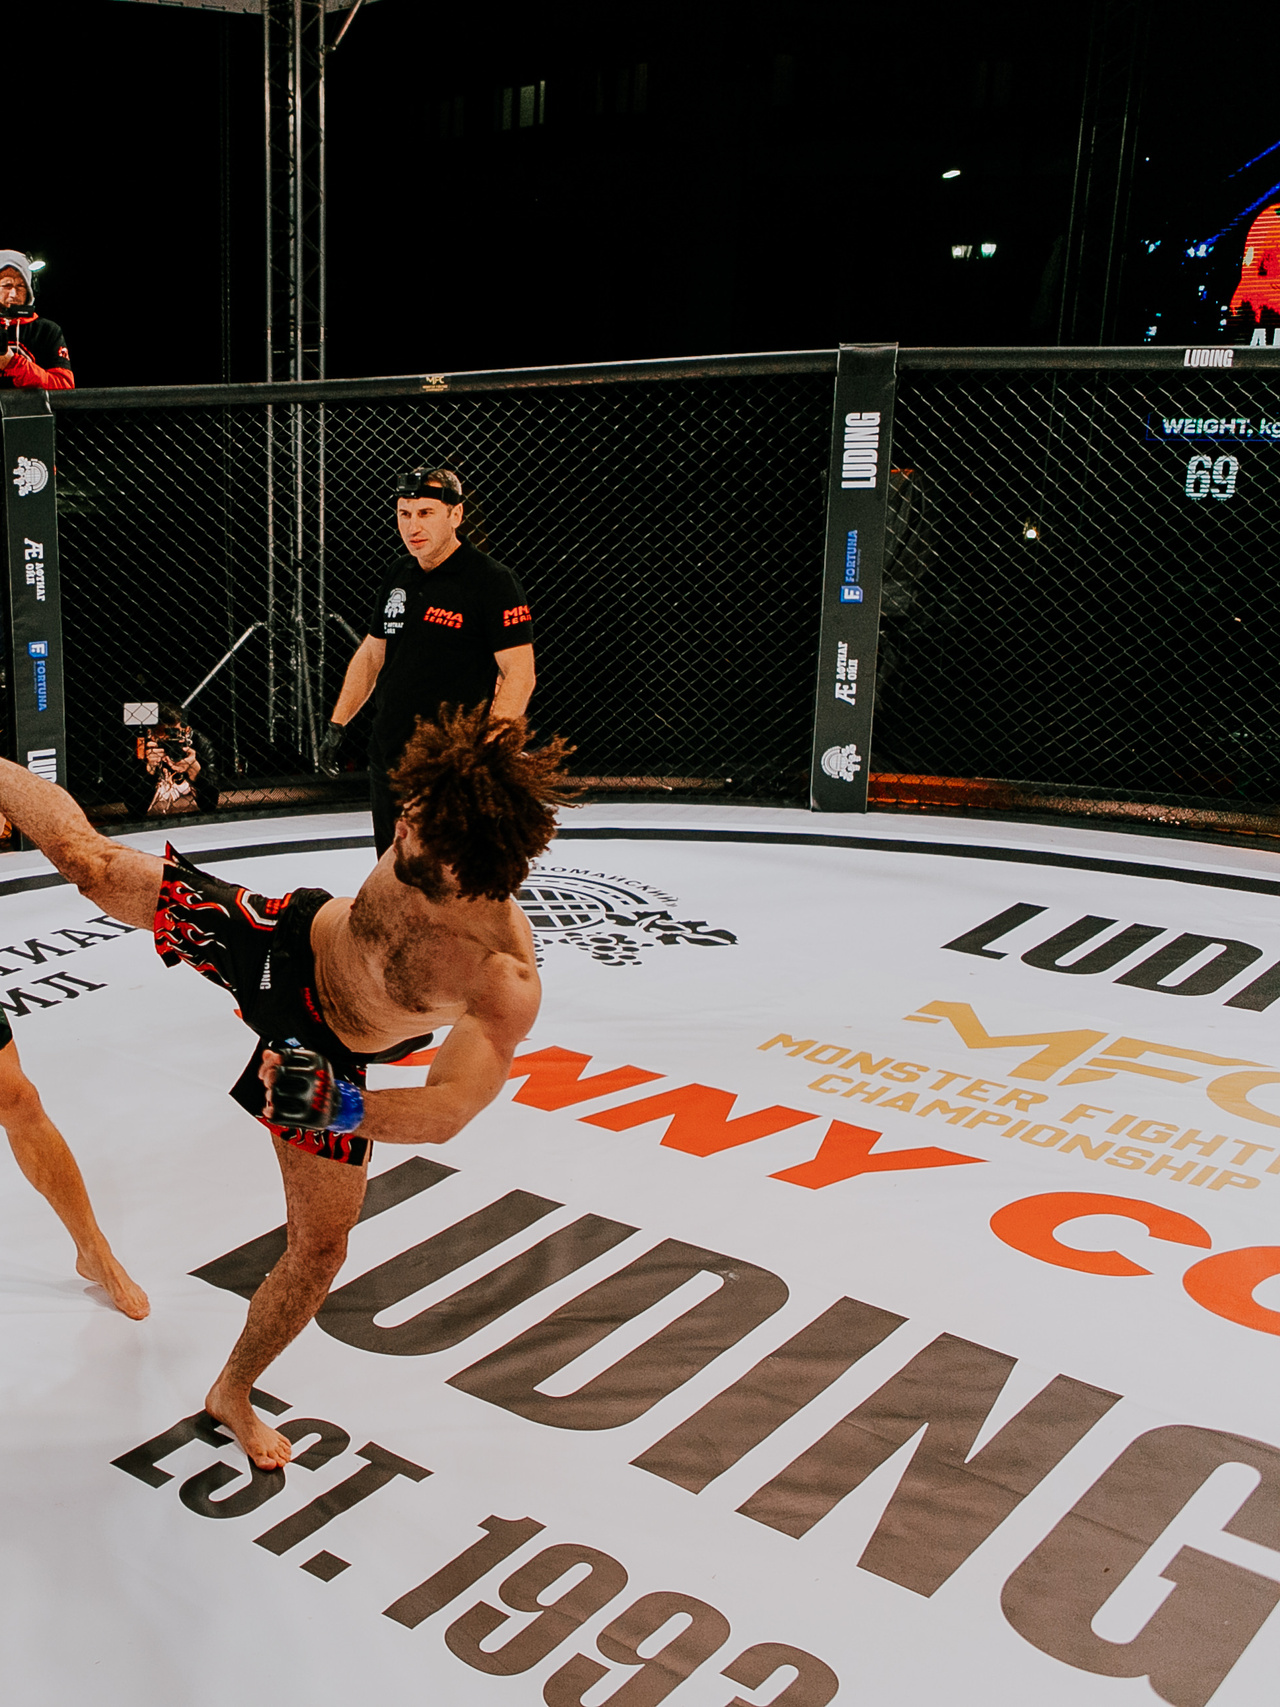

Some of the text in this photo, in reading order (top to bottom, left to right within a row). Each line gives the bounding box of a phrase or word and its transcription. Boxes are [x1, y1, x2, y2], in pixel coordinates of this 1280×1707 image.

[1184, 349, 1234, 367] LUDING
[841, 411, 880, 489] LUDING
[1162, 418, 1254, 437] WEIGHT,
[1185, 454, 1239, 501] 69
[845, 530, 858, 583] FORTUNA
[423, 614, 462, 629] SERIES
[425, 606, 464, 623] MMA
[37, 660, 47, 712] FORTUNA
[756, 1033, 1051, 1113] MONSTER
[806, 1074, 1262, 1191] CHAMPIONSHIP
[187, 1156, 1280, 1707] LUDING
[110, 1387, 434, 1583] EST.
